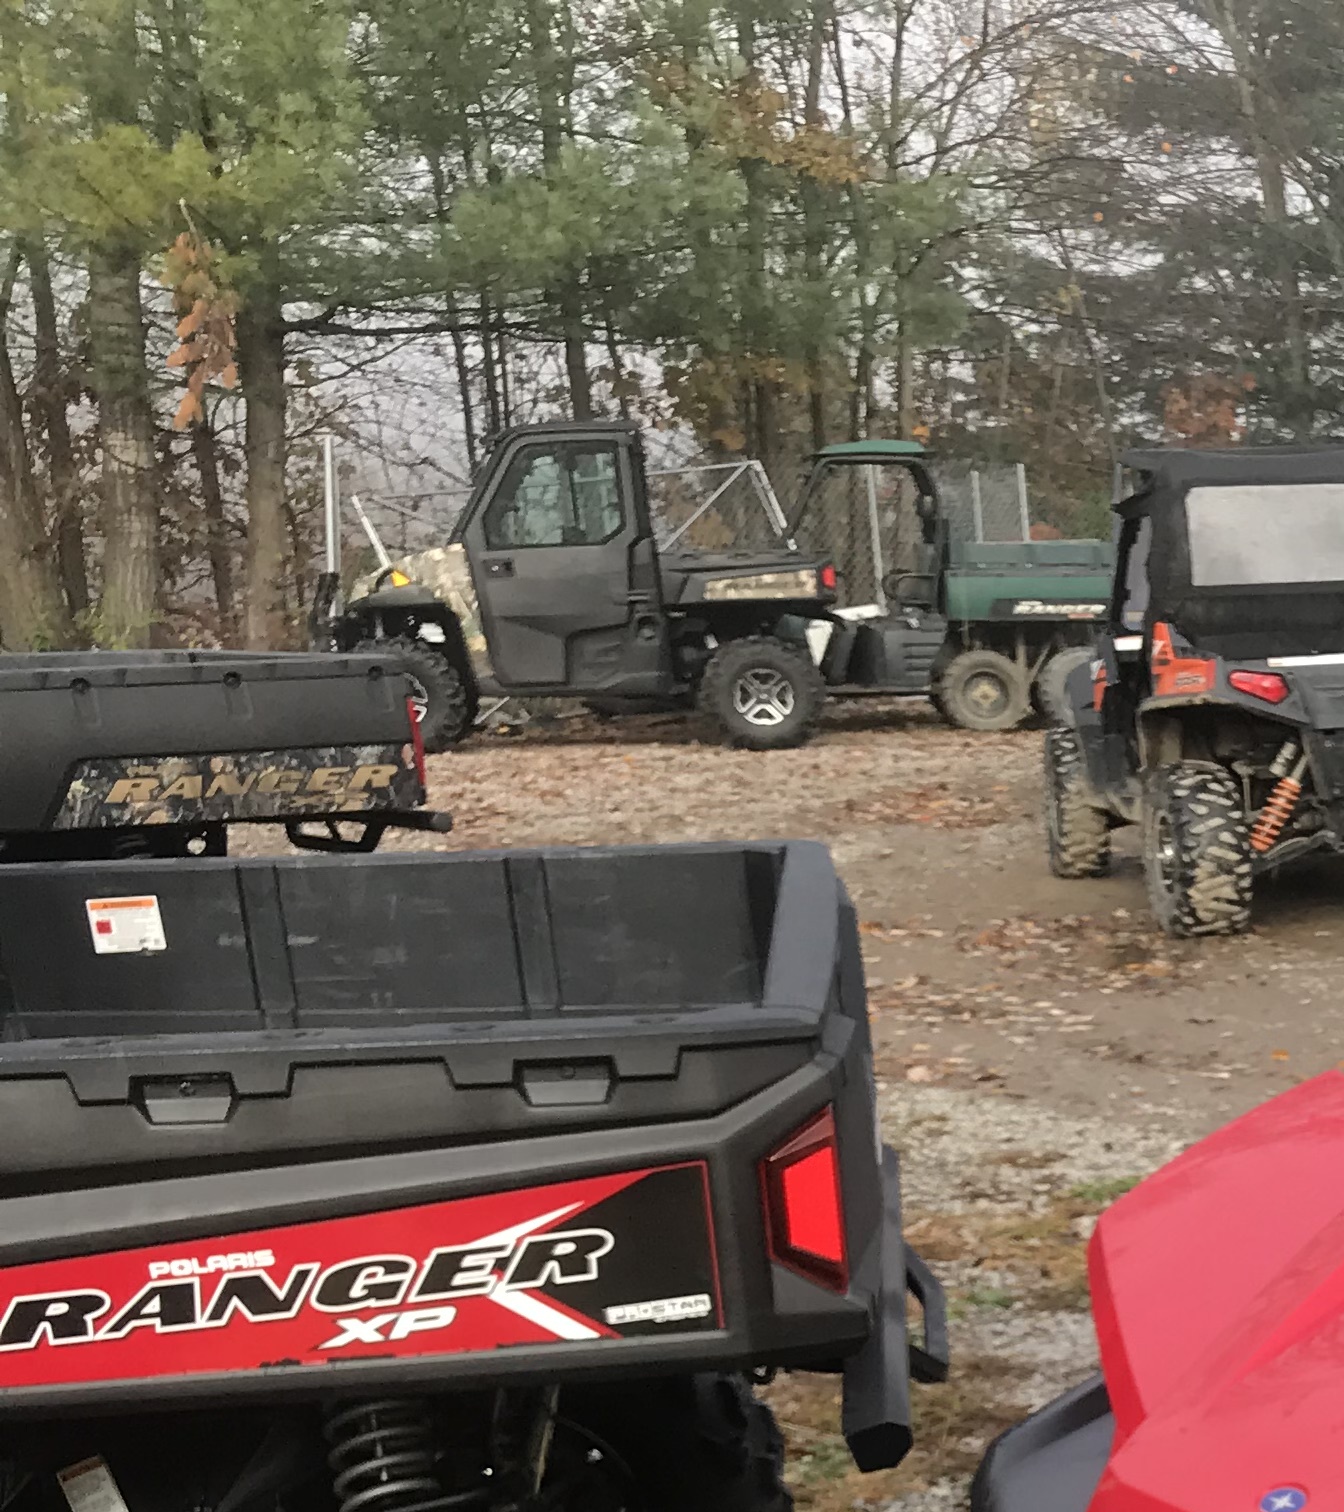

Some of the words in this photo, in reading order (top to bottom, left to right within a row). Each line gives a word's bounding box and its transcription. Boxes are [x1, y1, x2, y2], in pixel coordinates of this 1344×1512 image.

[104, 763, 398, 804] RANGER
[149, 1249, 276, 1279] POLARIS
[0, 1228, 615, 1352] RANGER
[314, 1306, 458, 1351] XP
